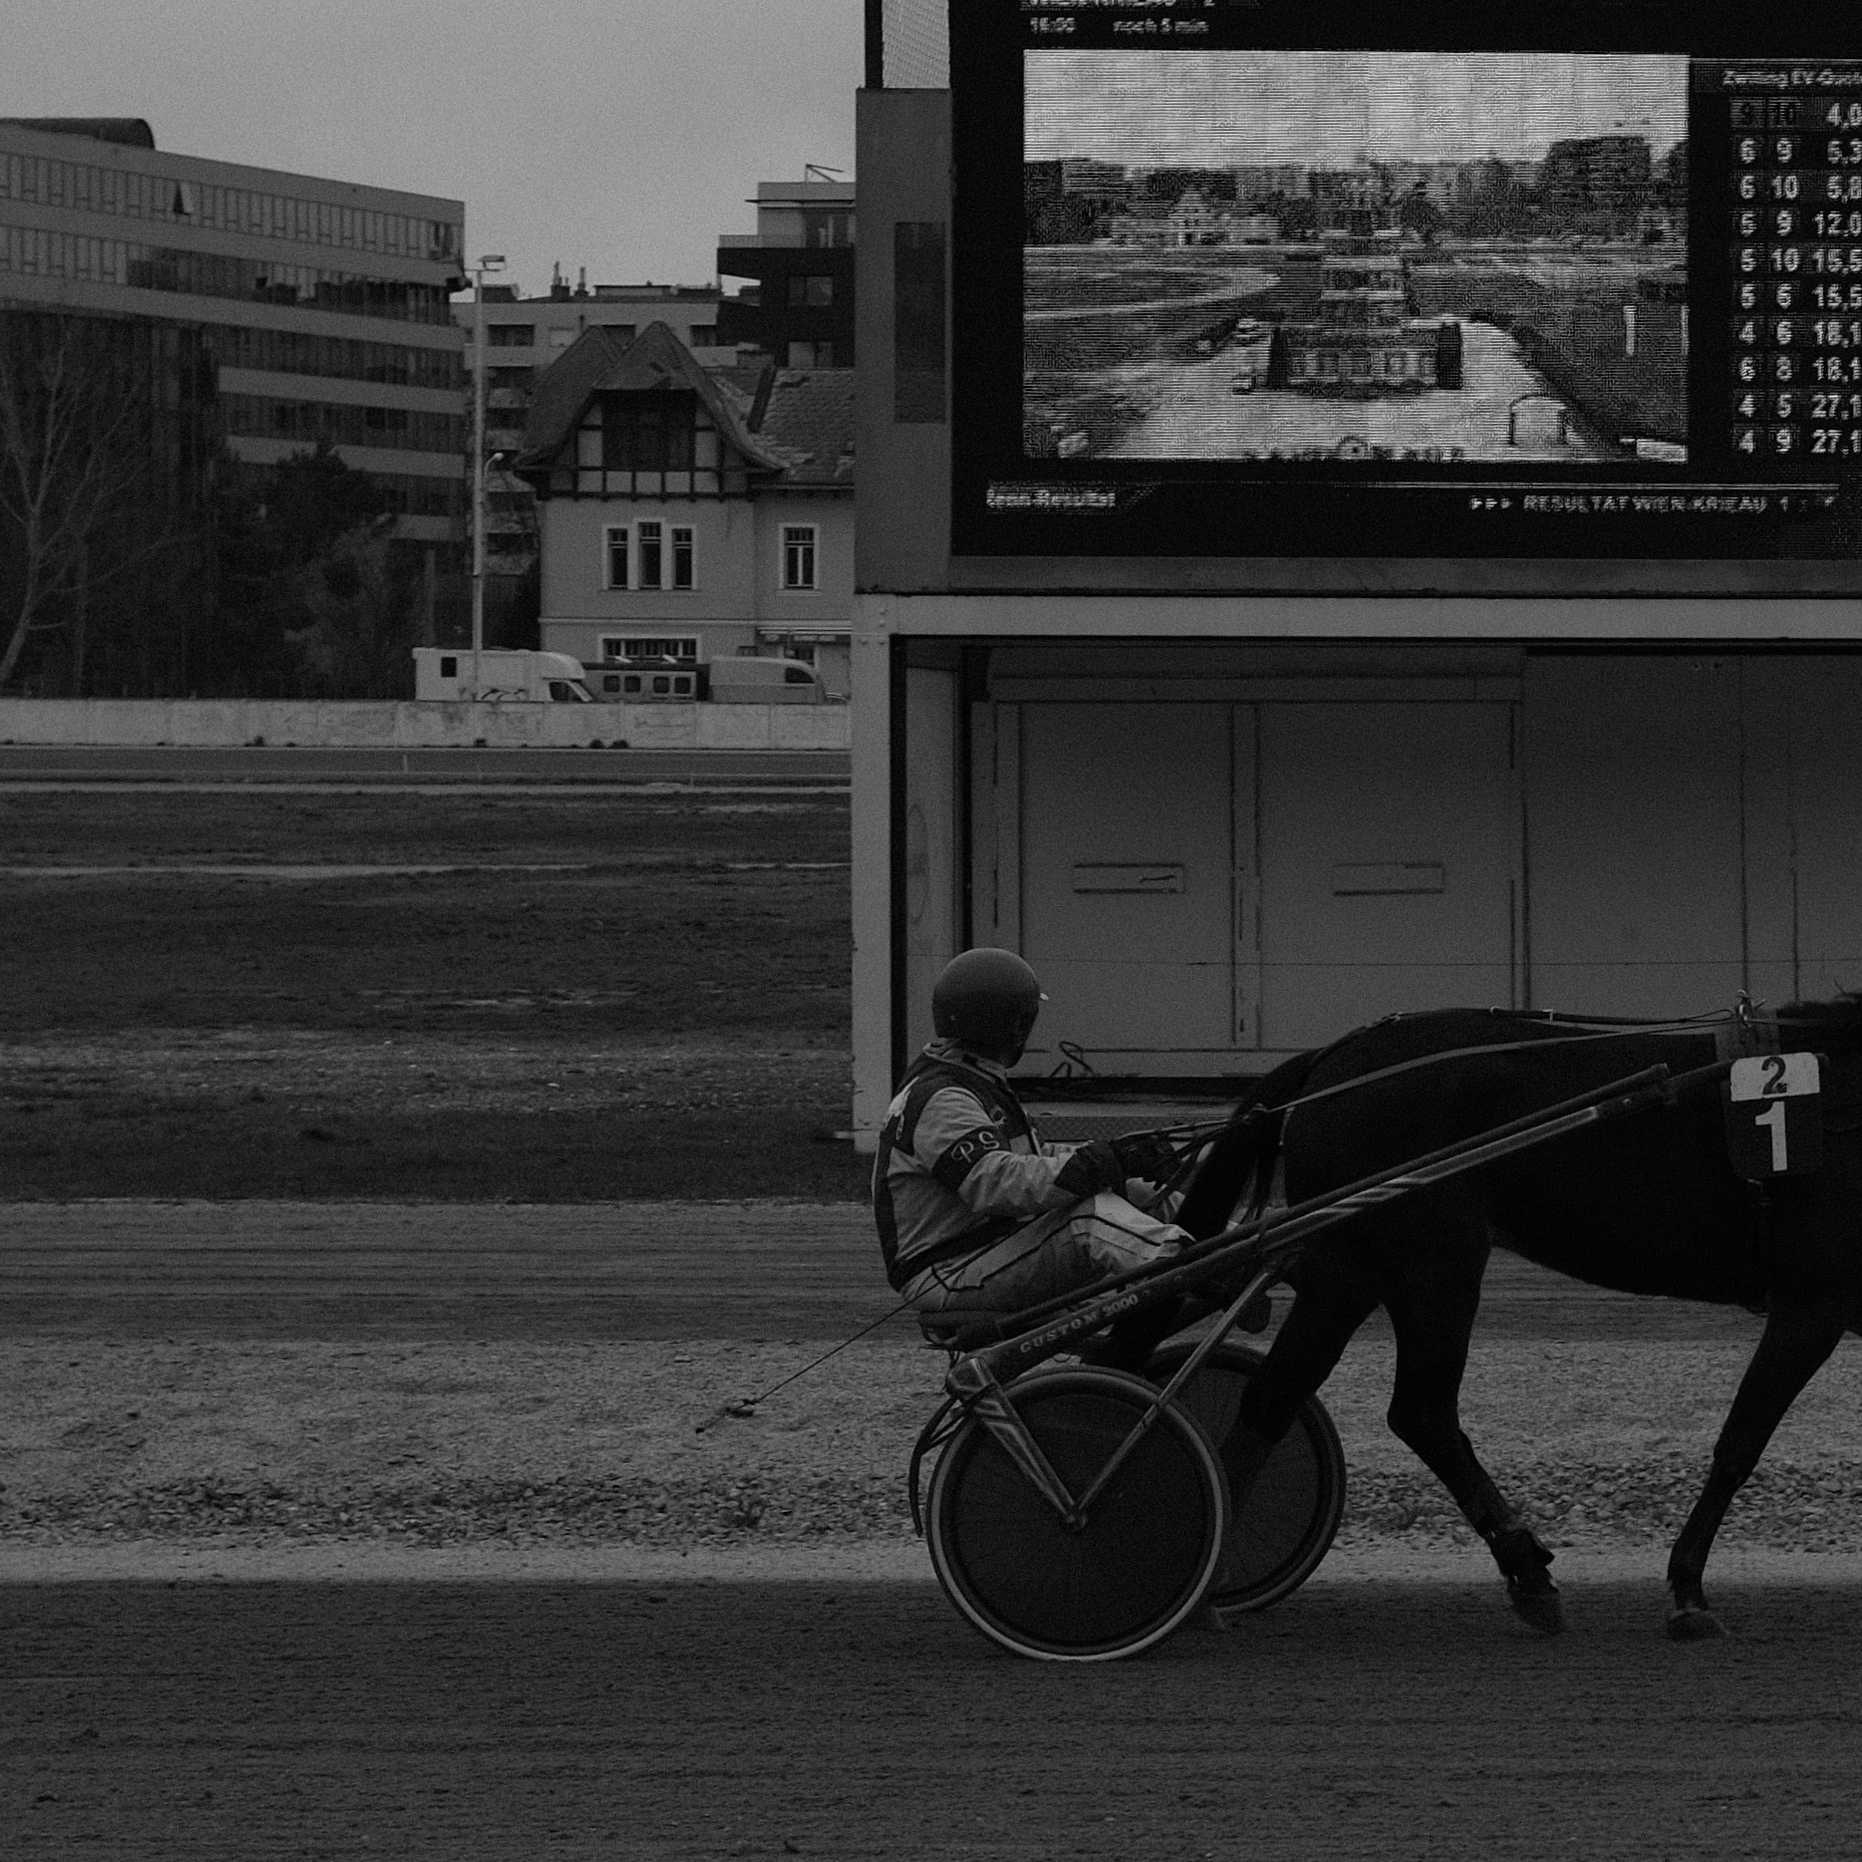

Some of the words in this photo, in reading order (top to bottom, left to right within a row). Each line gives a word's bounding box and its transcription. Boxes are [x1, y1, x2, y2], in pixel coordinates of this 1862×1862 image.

[1771, 102, 1799, 125] 10
[1739, 138, 1756, 163] 6
[1775, 138, 1793, 163] 9
[1739, 175, 1756, 200] 6
[1771, 175, 1799, 200] 10
[1739, 211, 1756, 236] 5
[1775, 211, 1793, 236] 9
[1739, 248, 1756, 272] 5
[1771, 248, 1799, 272] 10
[1739, 283, 1756, 308] 5
[1775, 283, 1793, 308] 6
[1739, 320, 1756, 345] 4
[1775, 320, 1793, 345] 6
[1739, 356, 1756, 382] 6
[1775, 356, 1793, 382] 8
[1739, 393, 1756, 418] 4
[1775, 393, 1793, 418] 5
[1739, 429, 1756, 454] 4
[1775, 429, 1793, 454] 9
[1522, 495, 1630, 514] RESULTAT
[1761, 1056, 1787, 1095] 2
[1755, 1101, 1788, 1172] 1
[1020, 1311, 1099, 1353] CUSTOM
